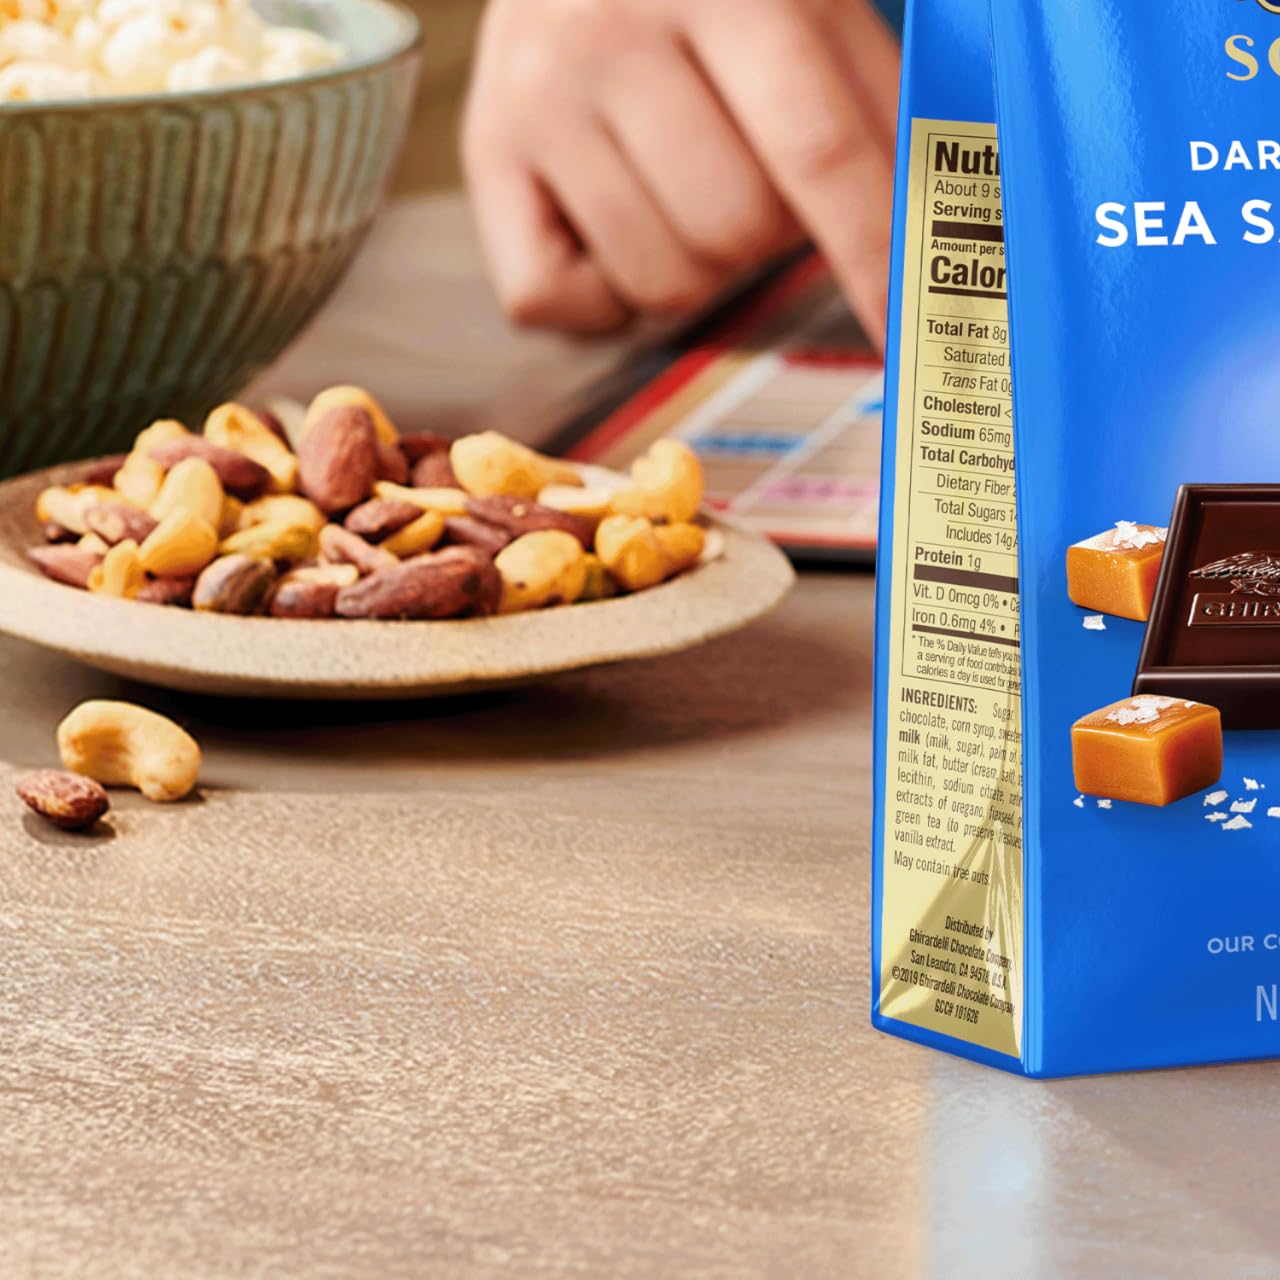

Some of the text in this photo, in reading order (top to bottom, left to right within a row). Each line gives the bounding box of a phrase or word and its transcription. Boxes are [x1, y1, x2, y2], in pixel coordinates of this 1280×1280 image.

[934, 179, 977, 197] About
[981, 183, 990, 198] 9
[933, 201, 991, 222] Serving
[1095, 200, 1217, 248] SEA
[931, 239, 976, 254] Amount
[979, 244, 996, 257] per
[926, 320, 1007, 344] Total Fat 8g
[944, 346, 1005, 367] Saturated
[941, 372, 976, 390] Trans
[980, 376, 999, 392] Fat
[923, 395, 1001, 418] Cholesterol
[921, 421, 1011, 447] Sodium 65mg
[920, 446, 955, 463] Total
[936, 473, 981, 494] Dietary
[984, 479, 1010, 496] Fiber
[934, 498, 964, 516] Total
[967, 502, 1006, 522] Sugars
[946, 525, 992, 545] Includes
[995, 532, 1013, 551] 14g
[915, 546, 982, 571] Protein 1g
[913, 583, 932, 599] Vit.
[936, 586, 944, 600] D
[948, 588, 980, 609] 0mcg
[982, 593, 999, 609] 0%
[912, 607, 935, 624] Iron
[940, 612, 976, 633] 0.6mg
[979, 618, 996, 634] 4%
[917, 651, 923, 660] a
[925, 652, 955, 667] serving
[957, 655, 966, 666] of
[966, 657, 984, 669] food
[947, 640, 966, 655] Daily
[967, 643, 987, 656] Value
[916, 664, 948, 677] calories
[957, 670, 971, 683] day
[901, 687, 978, 714] INGREDIENTS:
[900, 708, 948, 731] chocolate,
[951, 719, 971, 733] corn
[899, 728, 920, 744] milk
[898, 748, 919, 764] milk
[942, 755, 969, 773] butter
[897, 767, 935, 790] lecithin,
[943, 778, 974, 795] sodium
[896, 789, 933, 808] extracts
[938, 795, 948, 809] of
[896, 810, 920, 825] green
[927, 813, 940, 829] tea
[894, 829, 956, 853] vanilla extract.
[894, 850, 914, 871] May
[915, 857, 950, 876] contain
[953, 864, 969, 880] tree
[945, 915, 984, 939] Distributed
[910, 928, 985, 961] Ghirardelli Chocolate
[1207, 936, 1255, 954] OUR
[910, 949, 924, 966] San
[959, 962, 969, 977] CA
[919, 972, 956, 995] Ghirardelli
[957, 983, 989, 1007] Chocolate
